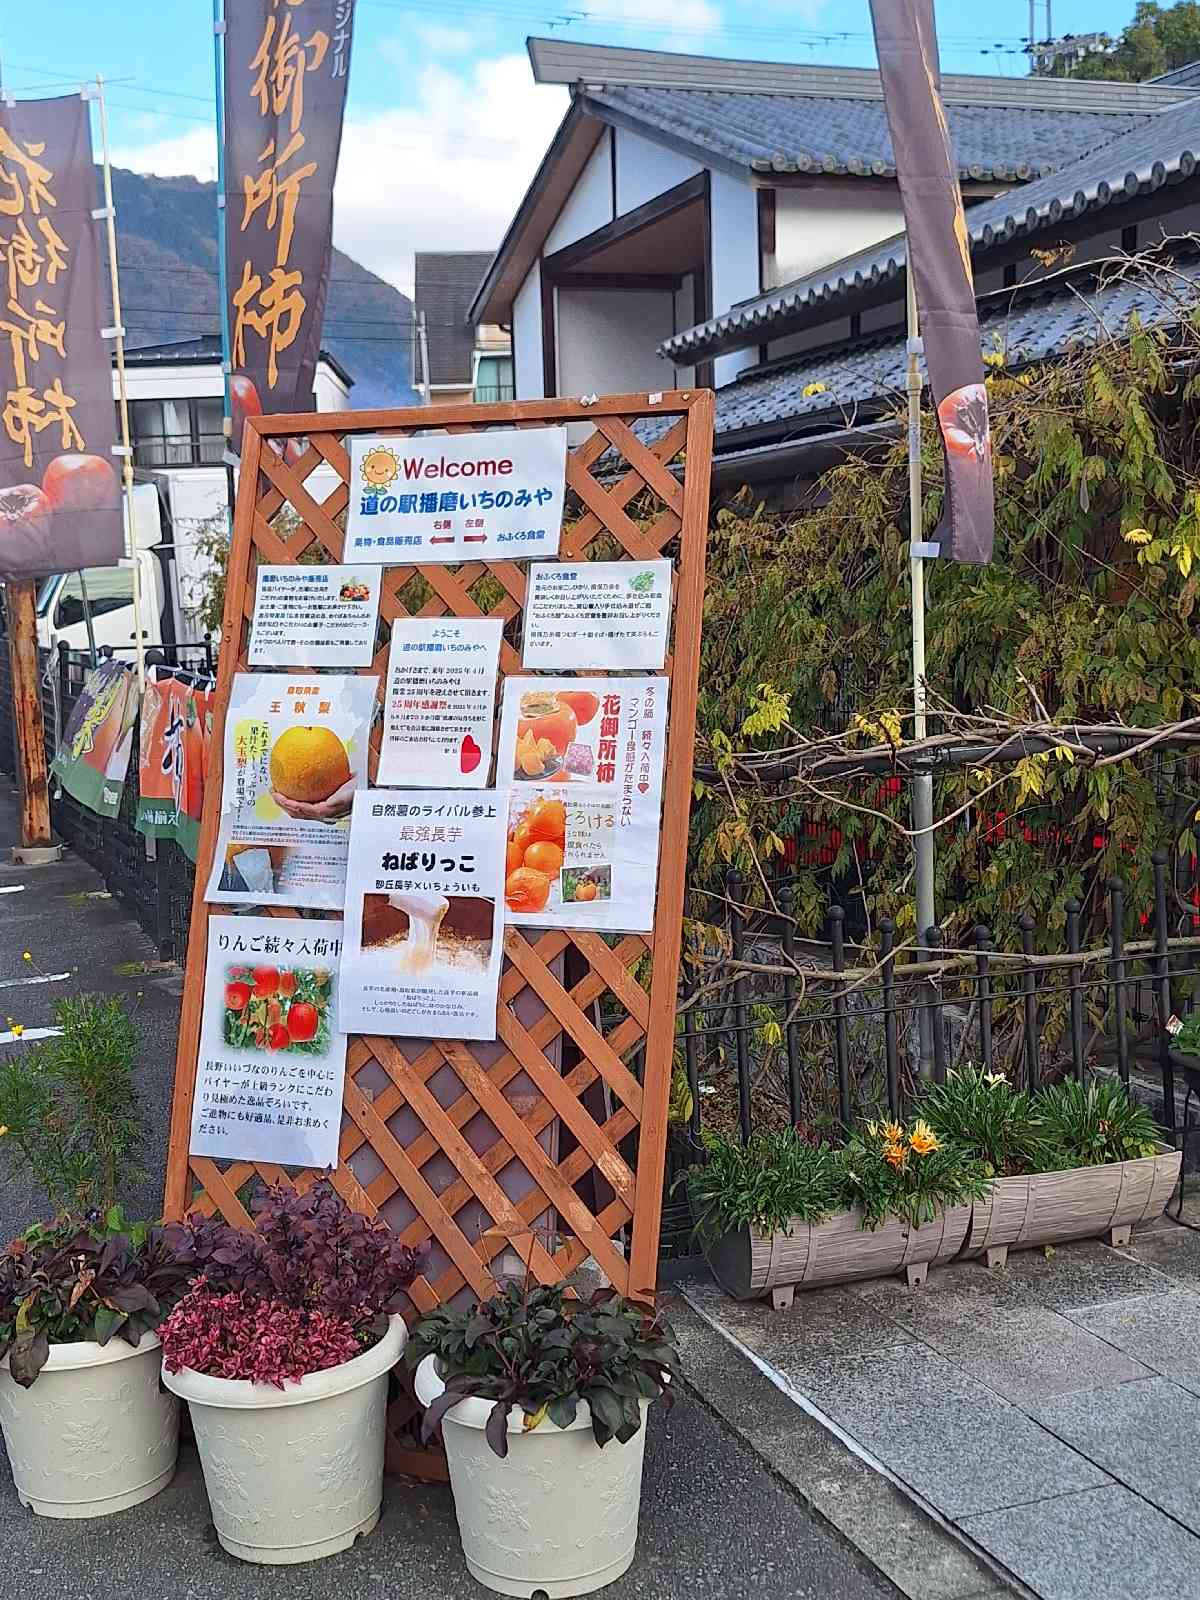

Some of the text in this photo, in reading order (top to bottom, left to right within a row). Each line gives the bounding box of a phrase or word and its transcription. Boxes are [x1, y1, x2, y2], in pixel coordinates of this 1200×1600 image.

[331, 0, 352, 79] ジナル
[232, 0, 330, 390] 御所柿
[403, 457, 513, 480] Welcome
[360, 487, 553, 516] 道の駅播磨いちのみや
[496, 529, 546, 543] おふくろ食堂
[432, 628, 461, 638] ようこそ
[595, 693, 622, 784] 花御所柿
[371, 803, 498, 818] 自然薯のライバル参上
[398, 824, 464, 843] 最強長芋
[381, 851, 476, 873] ねばりっこ
[217, 934, 343, 957] りんご続々入荷中
[204, 1060, 335, 1081] 長野いいづなのりんごを中心に
